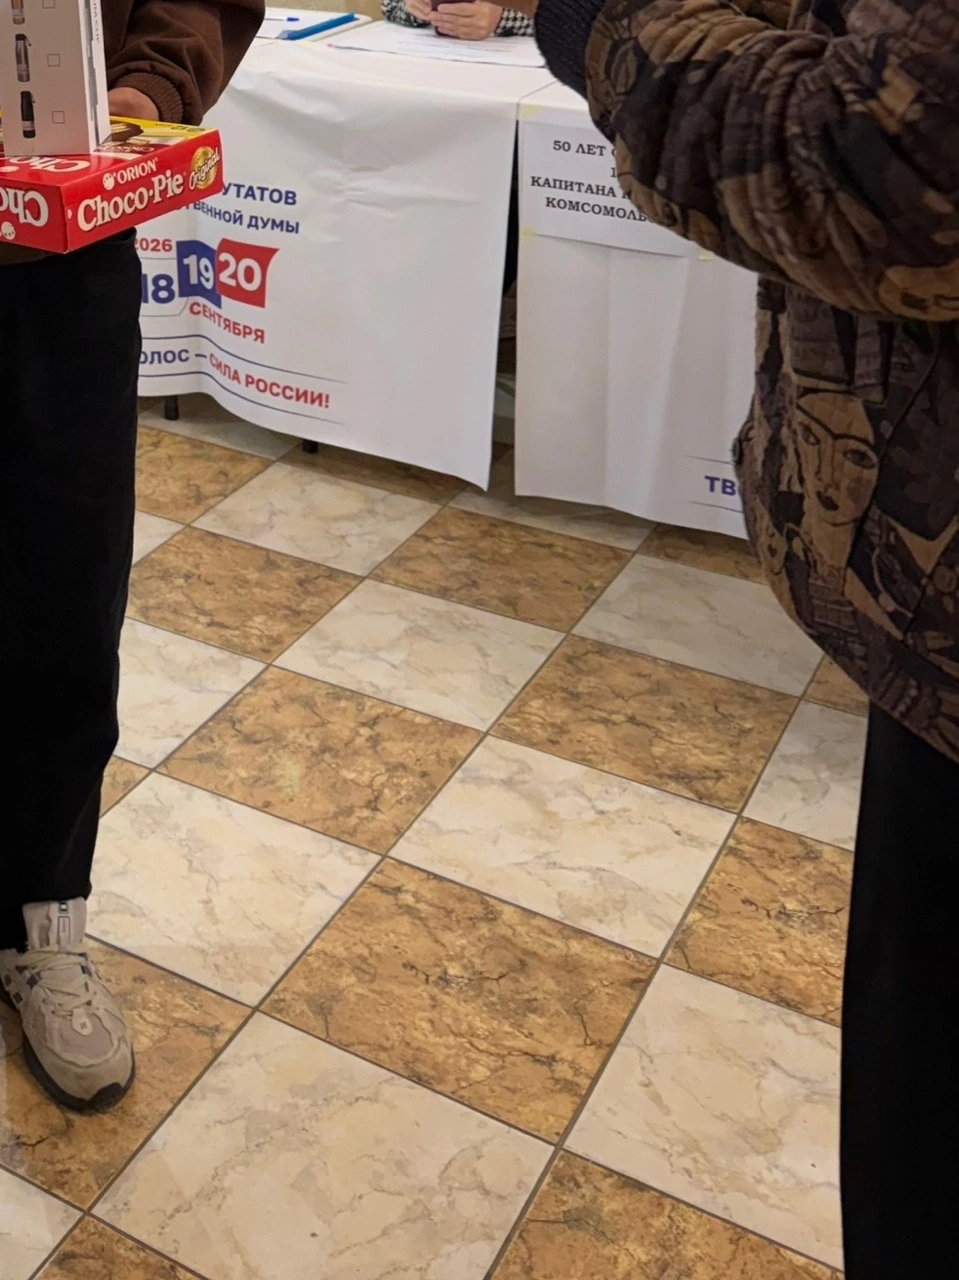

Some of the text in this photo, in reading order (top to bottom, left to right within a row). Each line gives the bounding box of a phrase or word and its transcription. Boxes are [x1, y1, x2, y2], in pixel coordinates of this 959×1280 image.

[553, 140, 571, 152] 50
[576, 143, 606, 156] ЛЕТ
[117, 160, 157, 184] ORION
[189, 147, 220, 190] Original
[222, 182, 297, 206] УТАТОВ
[530, 176, 617, 198] КАПИТАНА
[545, 197, 651, 222] КОМСОМОЛЬ
[247, 215, 300, 234] ДУМЫ
[183, 255, 214, 289] 19
[218, 252, 262, 291] 20
[189, 302, 265, 344] СЕНТЯБРЯ
[139, 349, 189, 364] ОЛОС
[209, 353, 241, 384] СИЛА
[245, 374, 330, 409] РОССИИ!
[704, 475, 736, 496] ТВ
